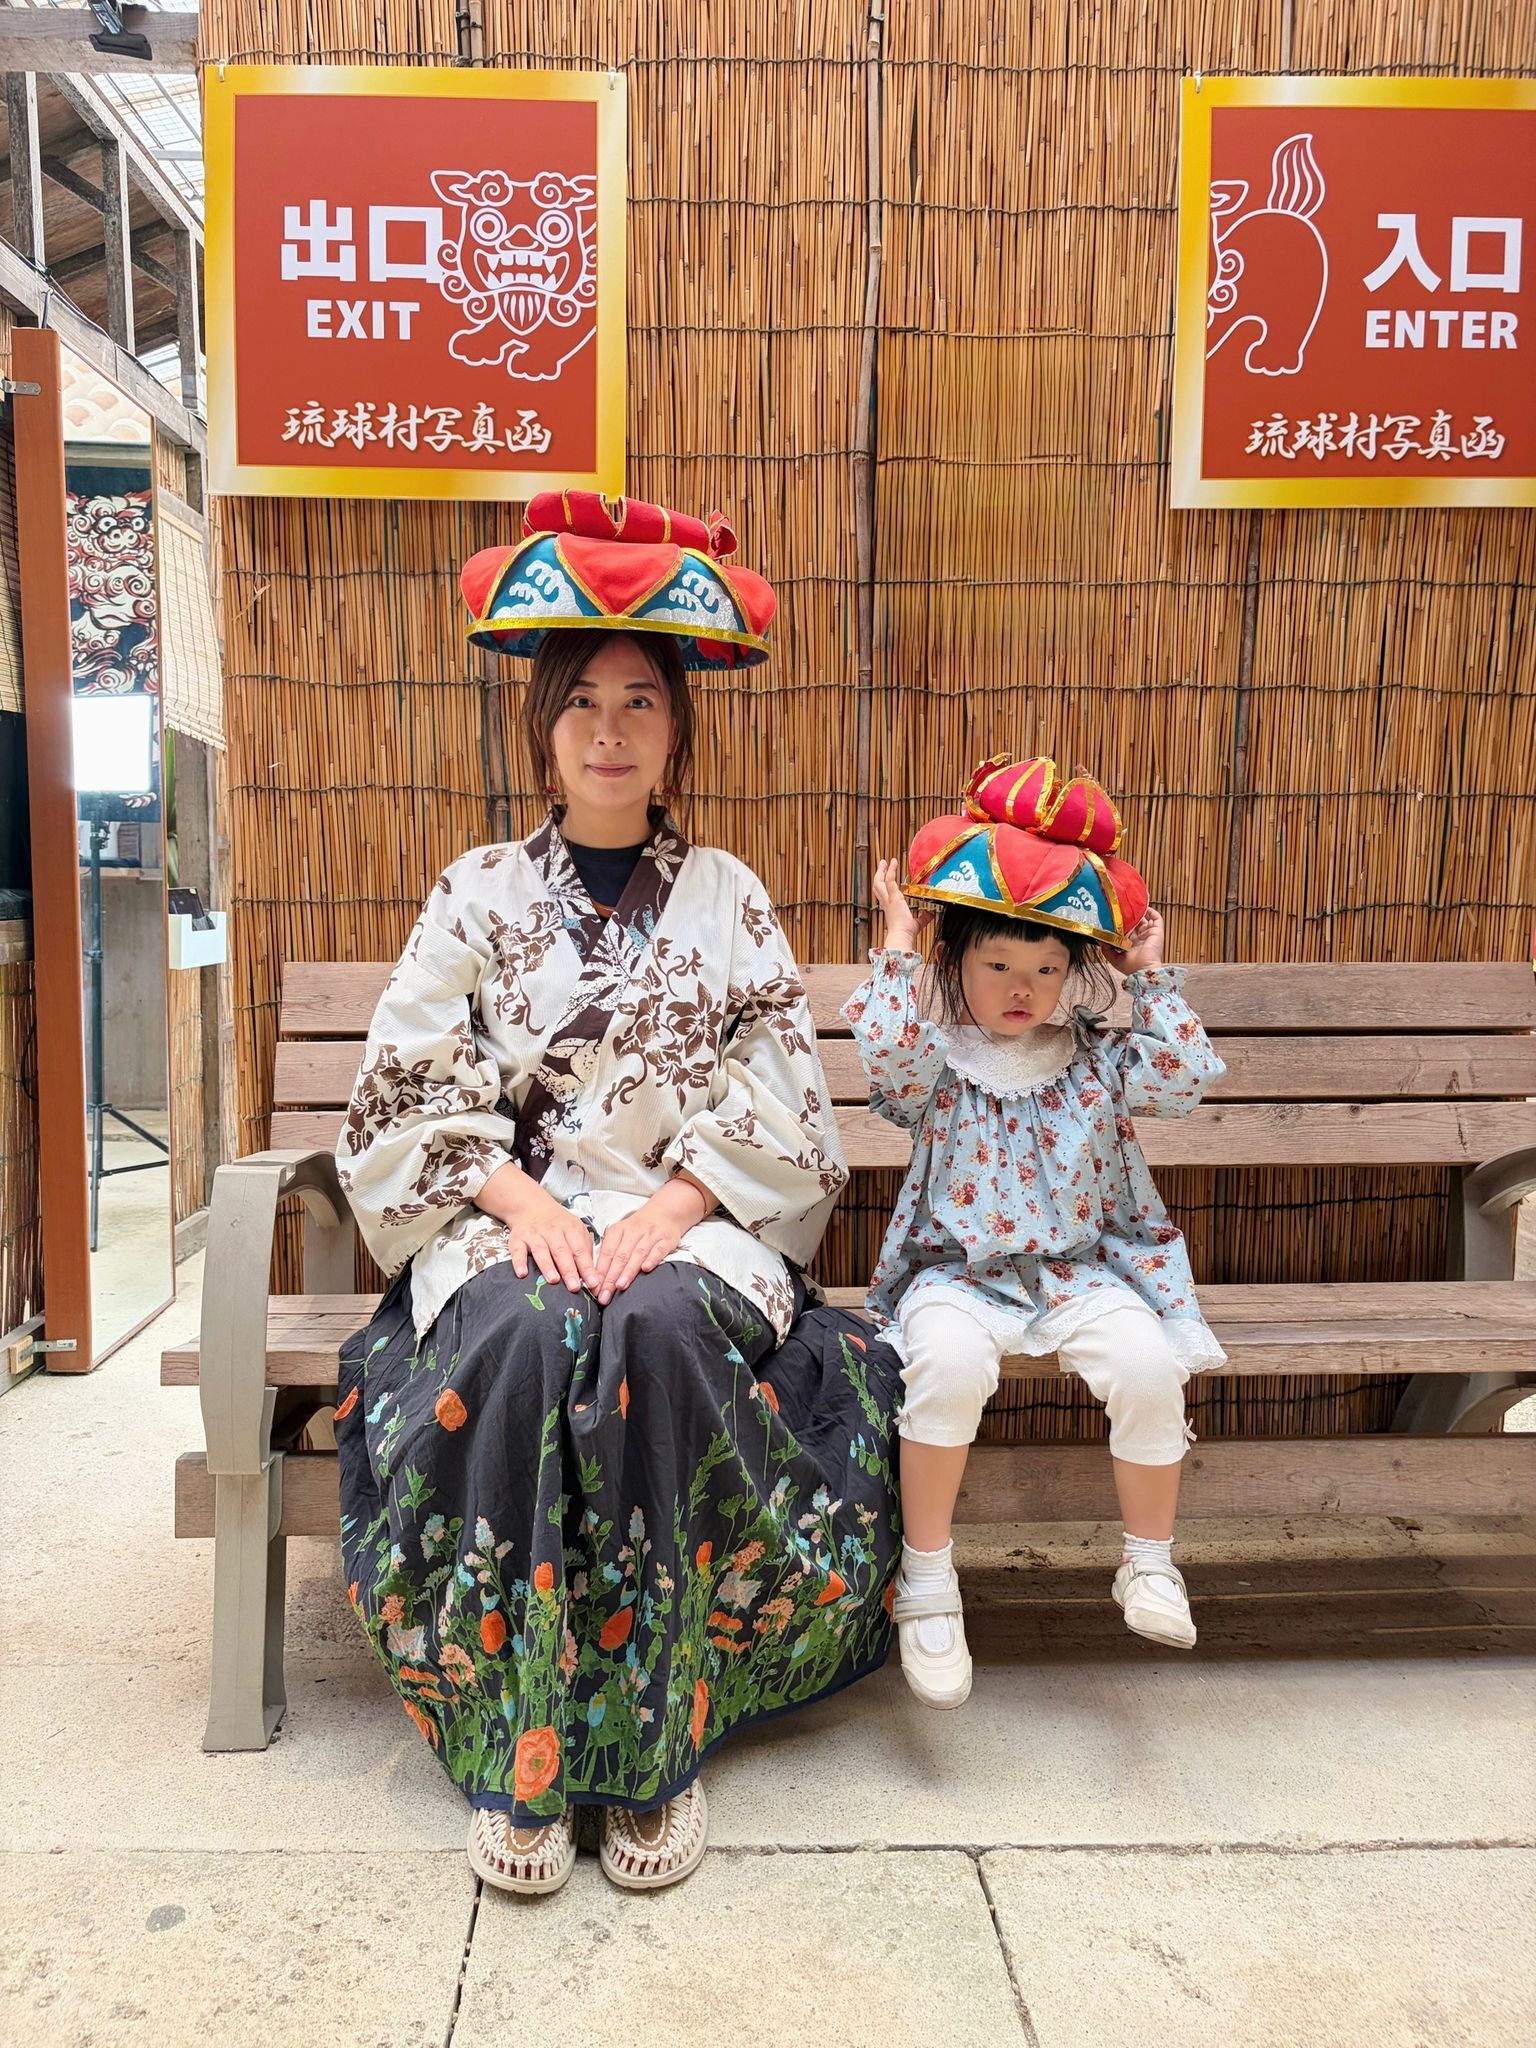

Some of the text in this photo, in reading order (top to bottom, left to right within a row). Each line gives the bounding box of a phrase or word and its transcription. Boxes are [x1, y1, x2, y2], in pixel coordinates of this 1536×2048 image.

[281, 200, 443, 283] 出口
[1362, 213, 1523, 293] 入口
[307, 300, 420, 340] EXIT
[1364, 310, 1518, 349] ENTER
[281, 401, 552, 453] 琉球村写真函
[1244, 409, 1506, 461] 琉球村写真函
